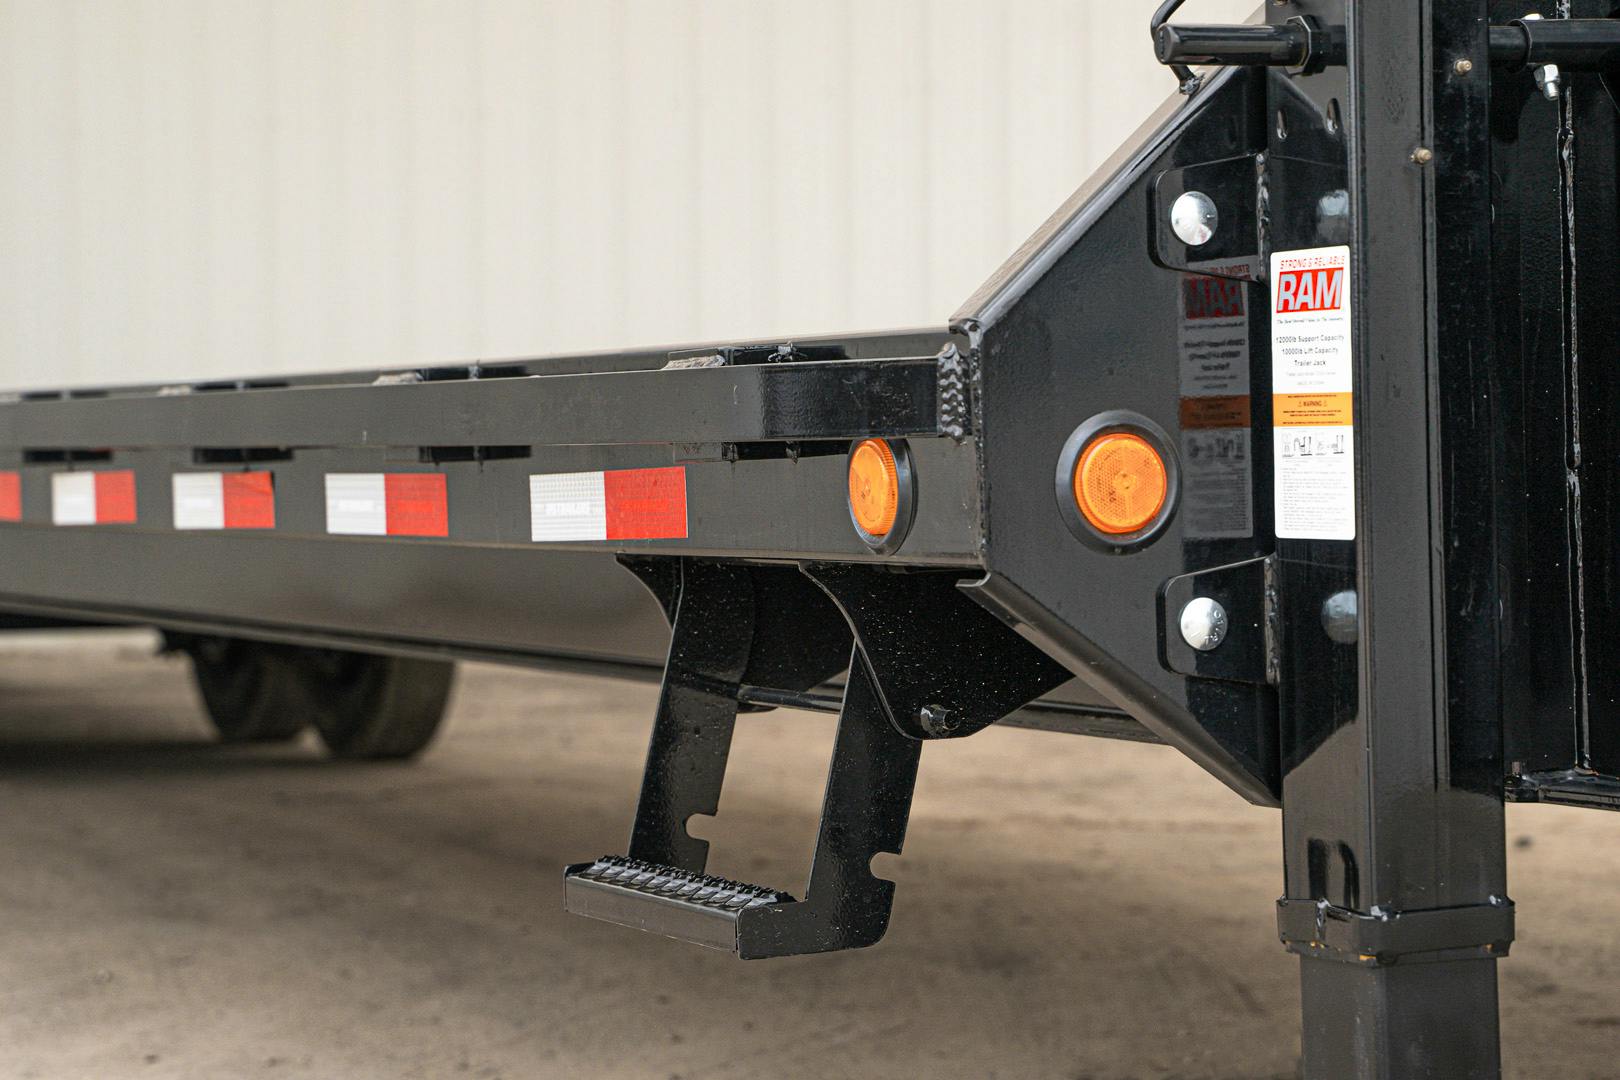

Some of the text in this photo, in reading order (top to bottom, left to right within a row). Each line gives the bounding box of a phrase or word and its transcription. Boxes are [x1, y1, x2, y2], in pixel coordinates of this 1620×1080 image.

[1277, 270, 1343, 311] RAM
[1298, 335, 1320, 343] Support
[1321, 333, 1345, 343] Capacity
[1315, 346, 1339, 356] Capacity
[1294, 359, 1312, 367] Trailer
